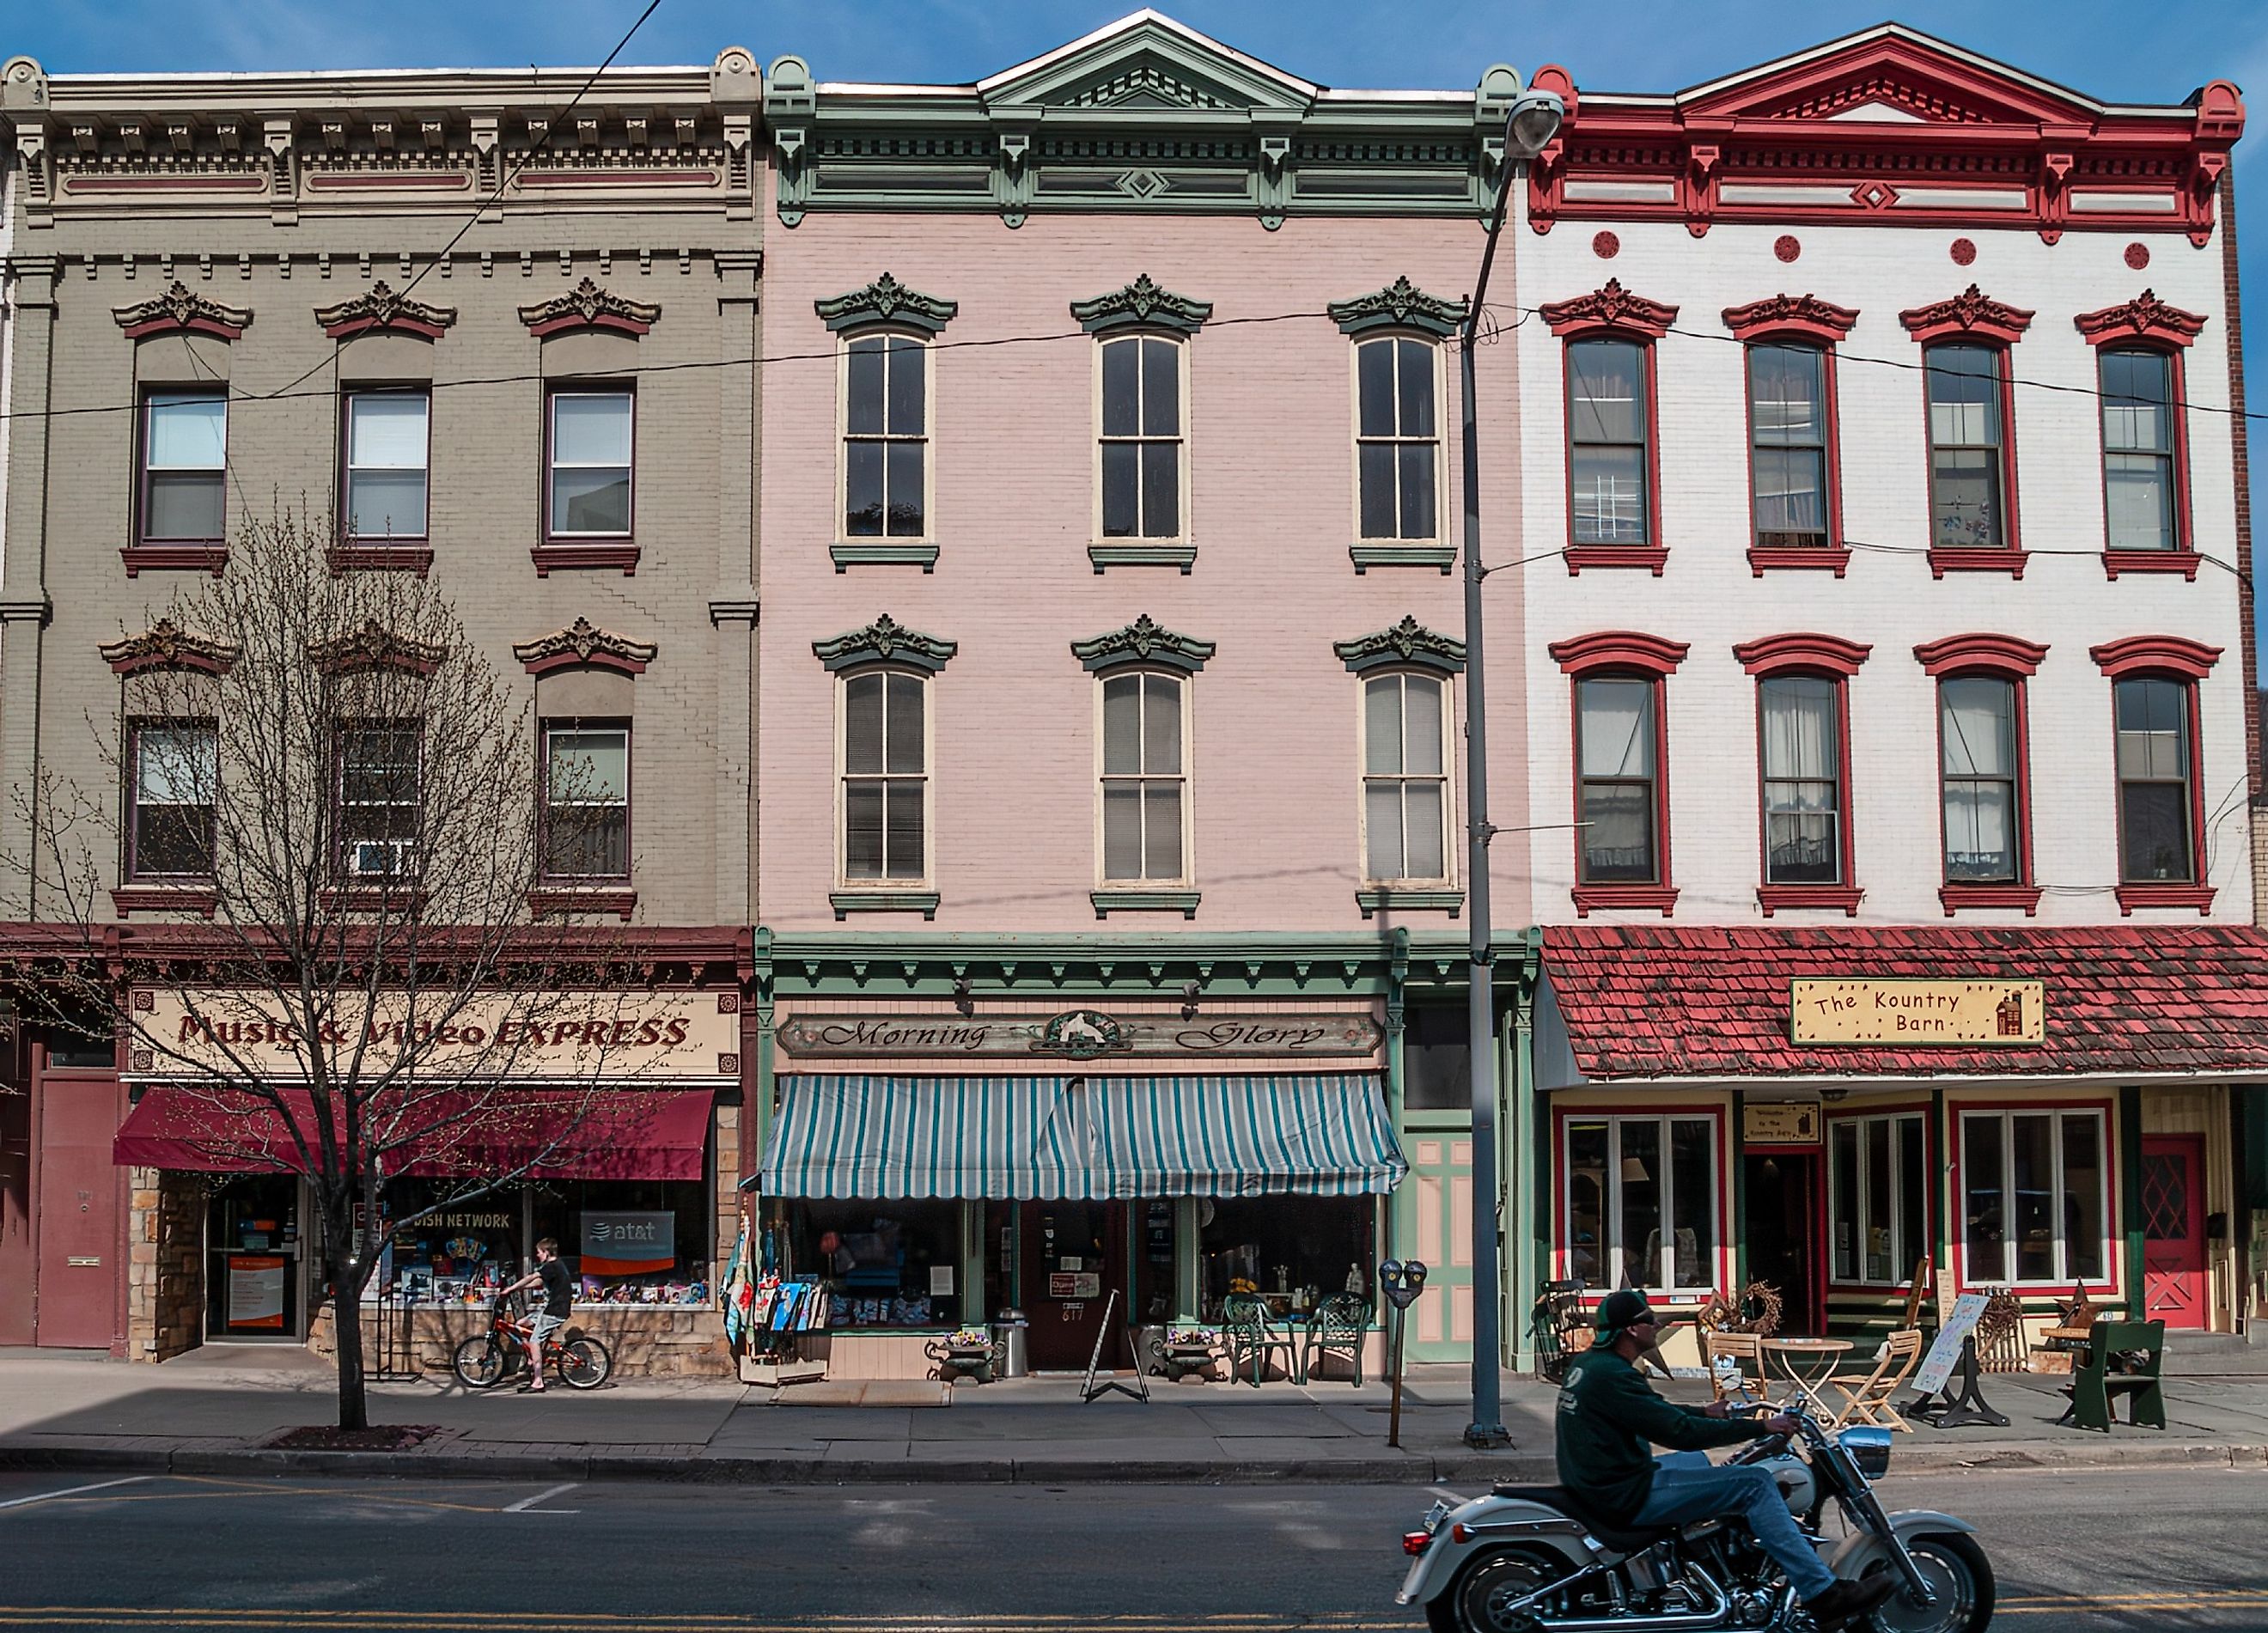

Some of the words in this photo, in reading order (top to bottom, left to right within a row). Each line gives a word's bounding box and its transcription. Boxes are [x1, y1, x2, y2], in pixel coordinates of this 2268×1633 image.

[1814, 996, 1856, 1015] The
[1875, 991, 1960, 1012] Kountry
[494, 1017, 691, 1046] EXPRESS
[1896, 1015, 1945, 1031] Barn
[822, 1021, 991, 1050] Morning
[1175, 1022, 1325, 1049] Glory
[447, 1214, 509, 1228] NETWORK
[614, 1222, 655, 1240] at&t
[1062, 1309, 1082, 1322] 617
